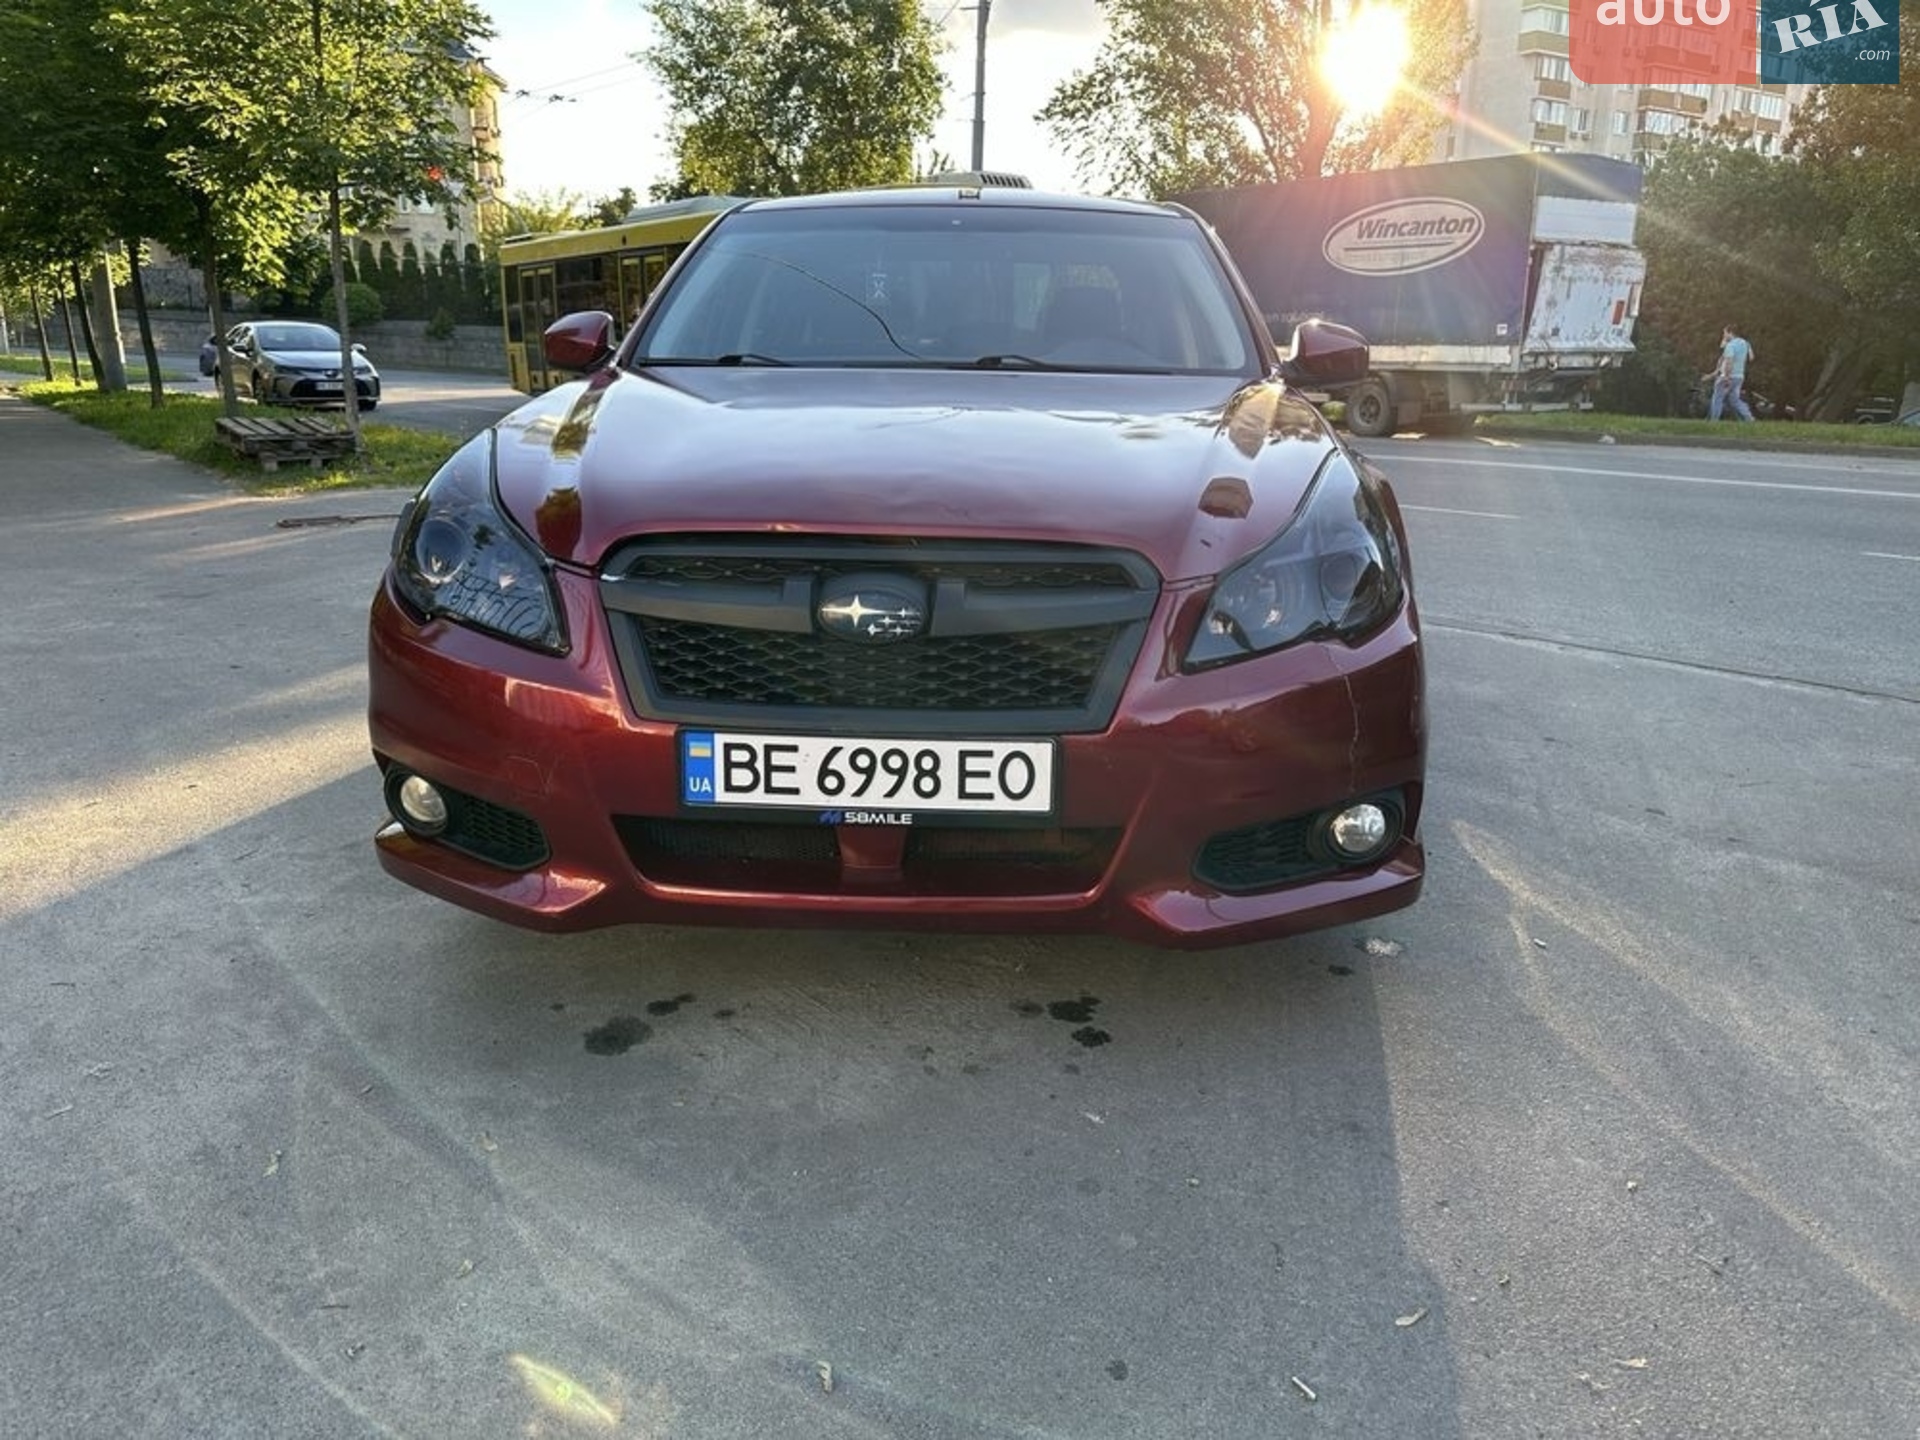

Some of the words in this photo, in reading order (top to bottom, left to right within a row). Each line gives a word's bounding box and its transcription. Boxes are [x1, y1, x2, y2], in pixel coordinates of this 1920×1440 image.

[1356, 213, 1475, 240] Wincanton
[689, 777, 711, 793] UA
[722, 743, 800, 796] BE
[816, 746, 942, 799] 6998
[957, 750, 1036, 800] EO
